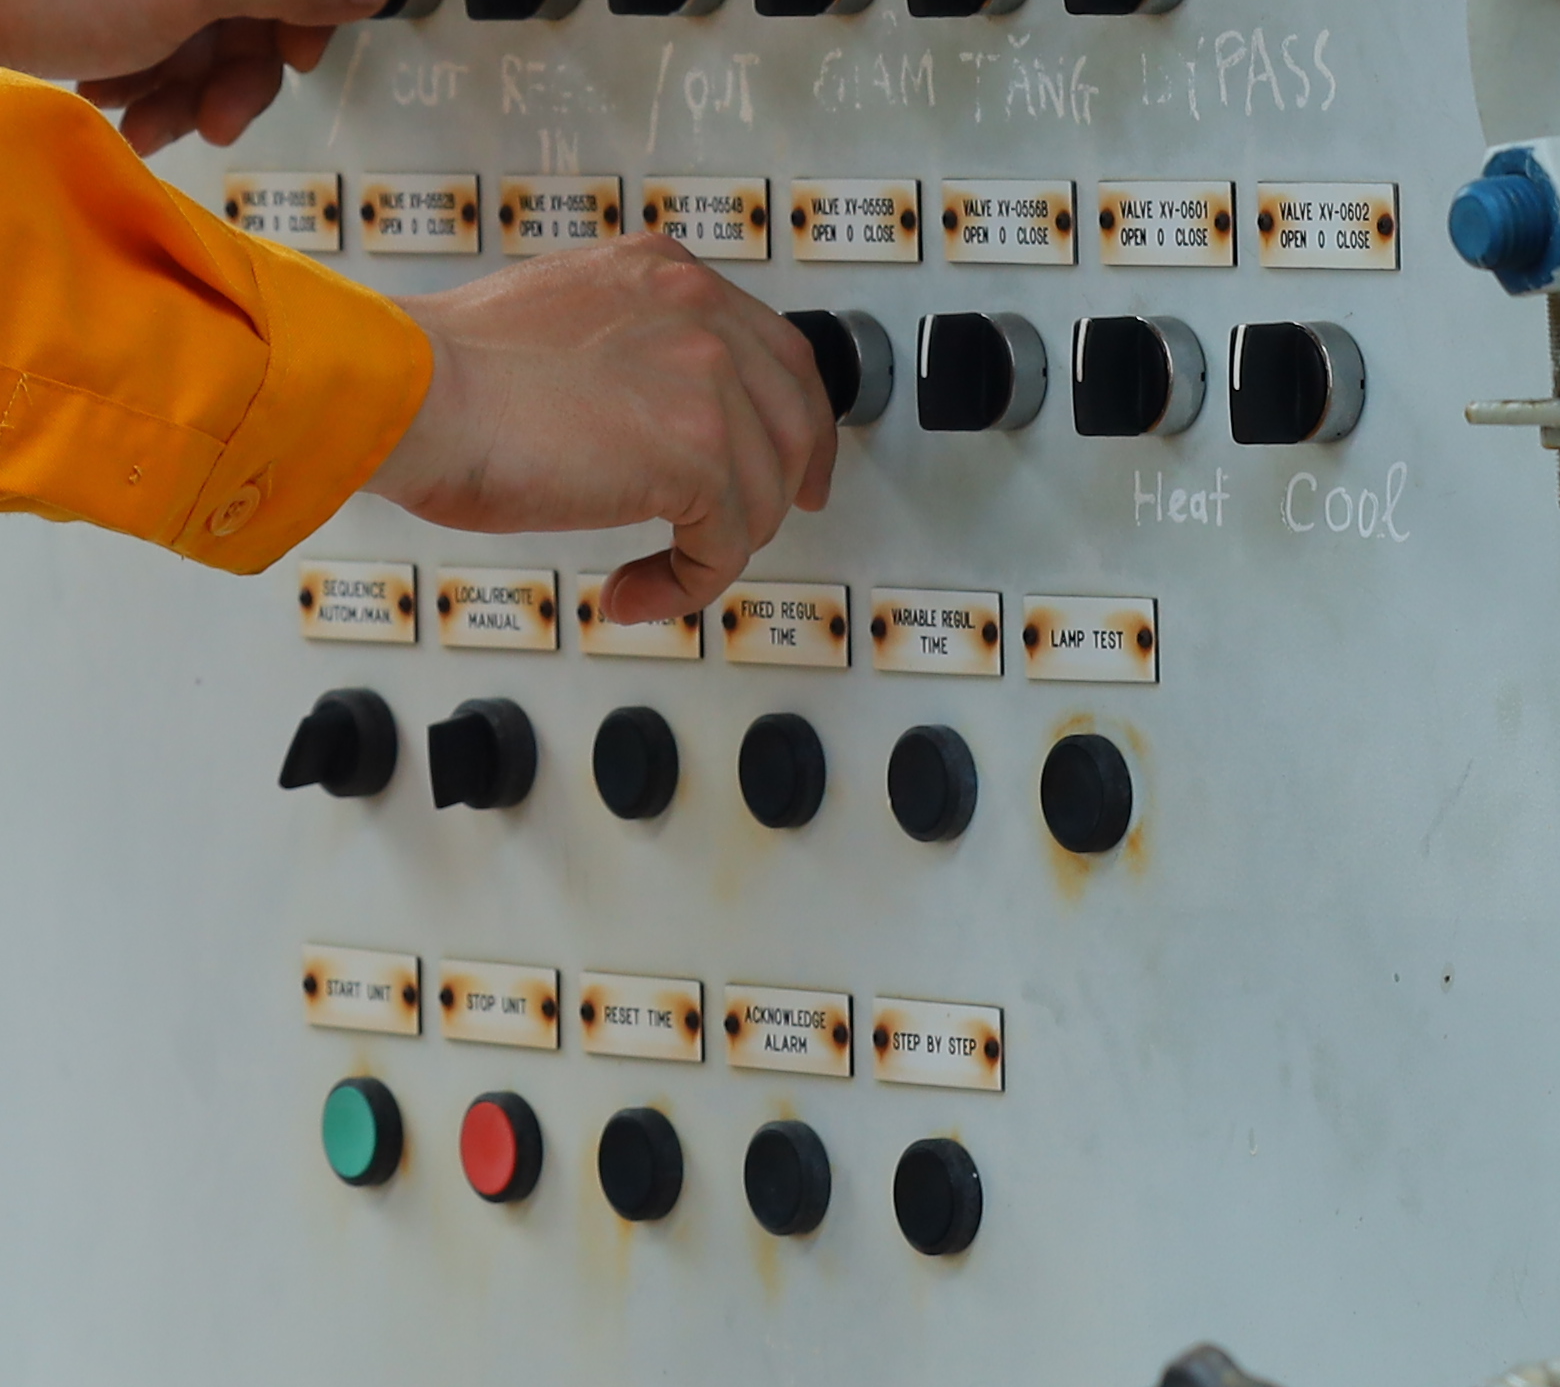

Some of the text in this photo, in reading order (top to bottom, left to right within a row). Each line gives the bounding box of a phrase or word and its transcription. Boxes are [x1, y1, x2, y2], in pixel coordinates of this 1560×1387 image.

[519, 195, 545, 211] VALVE
[662, 196, 691, 212] VALVE
[811, 198, 895, 216] VALVE XV-0555B
[963, 200, 1048, 217] VALVE XV-0556B
[1120, 201, 1209, 219] VALVE XV-0601
[1279, 202, 1370, 221] VALVE XV-0602
[520, 220, 598, 238] OPEN CLOSE
[713, 223, 744, 240] CLOSE
[811, 224, 895, 242] OPEN CLOSE
[963, 226, 1049, 245] OPEN CLOSE
[1120, 228, 1209, 246] OPEN CLOSE
[1280, 230, 1370, 249] OPEN CLOSE
[1133, 461, 1410, 543] Heat Cool
[323, 579, 386, 599] SEQUENCE
[454, 586, 534, 605] LOCAL/REMOTE
[740, 601, 823, 621] FIXED REGUL.
[891, 608, 976, 629] VARIABLE REGUL.
[468, 613, 520, 631] MANUAL
[770, 627, 797, 646] TIME
[920, 636, 948, 654] TIME
[1051, 630, 1123, 649] LAMP TEST
[326, 979, 391, 1001] START UNIT
[466, 993, 527, 1015] STOP UNIT
[604, 1006, 673, 1028] RESET TIME
[744, 1006, 827, 1029] ACKNOWLEDGE
[763, 1035, 808, 1053] ALARM
[893, 1033, 977, 1056] STEP BY STEP
